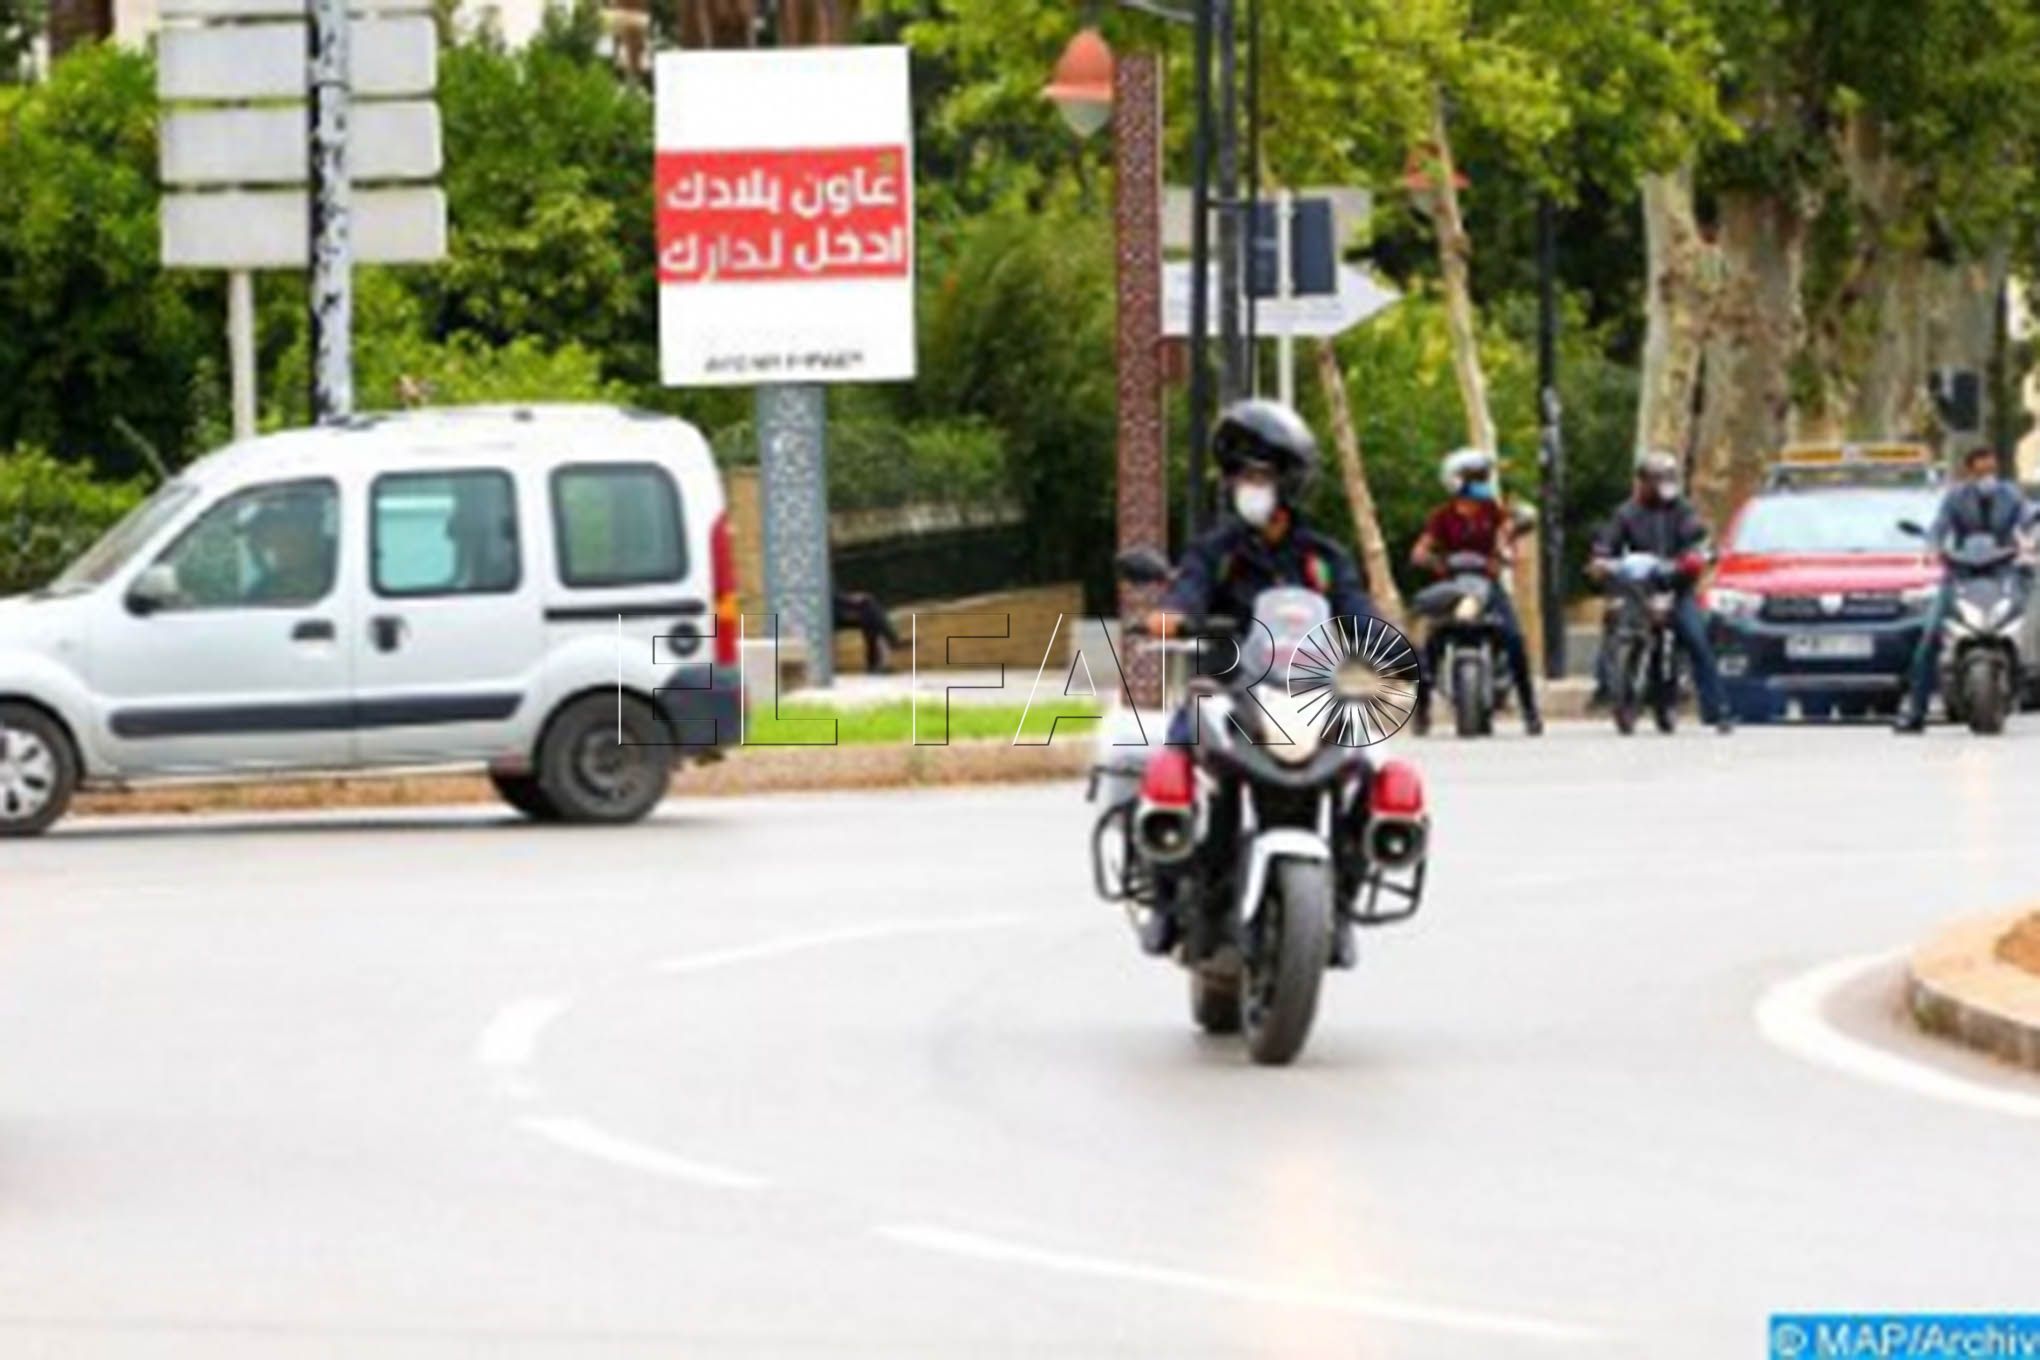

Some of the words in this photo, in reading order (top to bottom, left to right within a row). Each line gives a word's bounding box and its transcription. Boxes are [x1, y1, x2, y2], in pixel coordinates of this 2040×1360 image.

[665, 167, 781, 215] بلادك
[790, 166, 898, 217] عاون
[659, 227, 783, 282] لدارك
